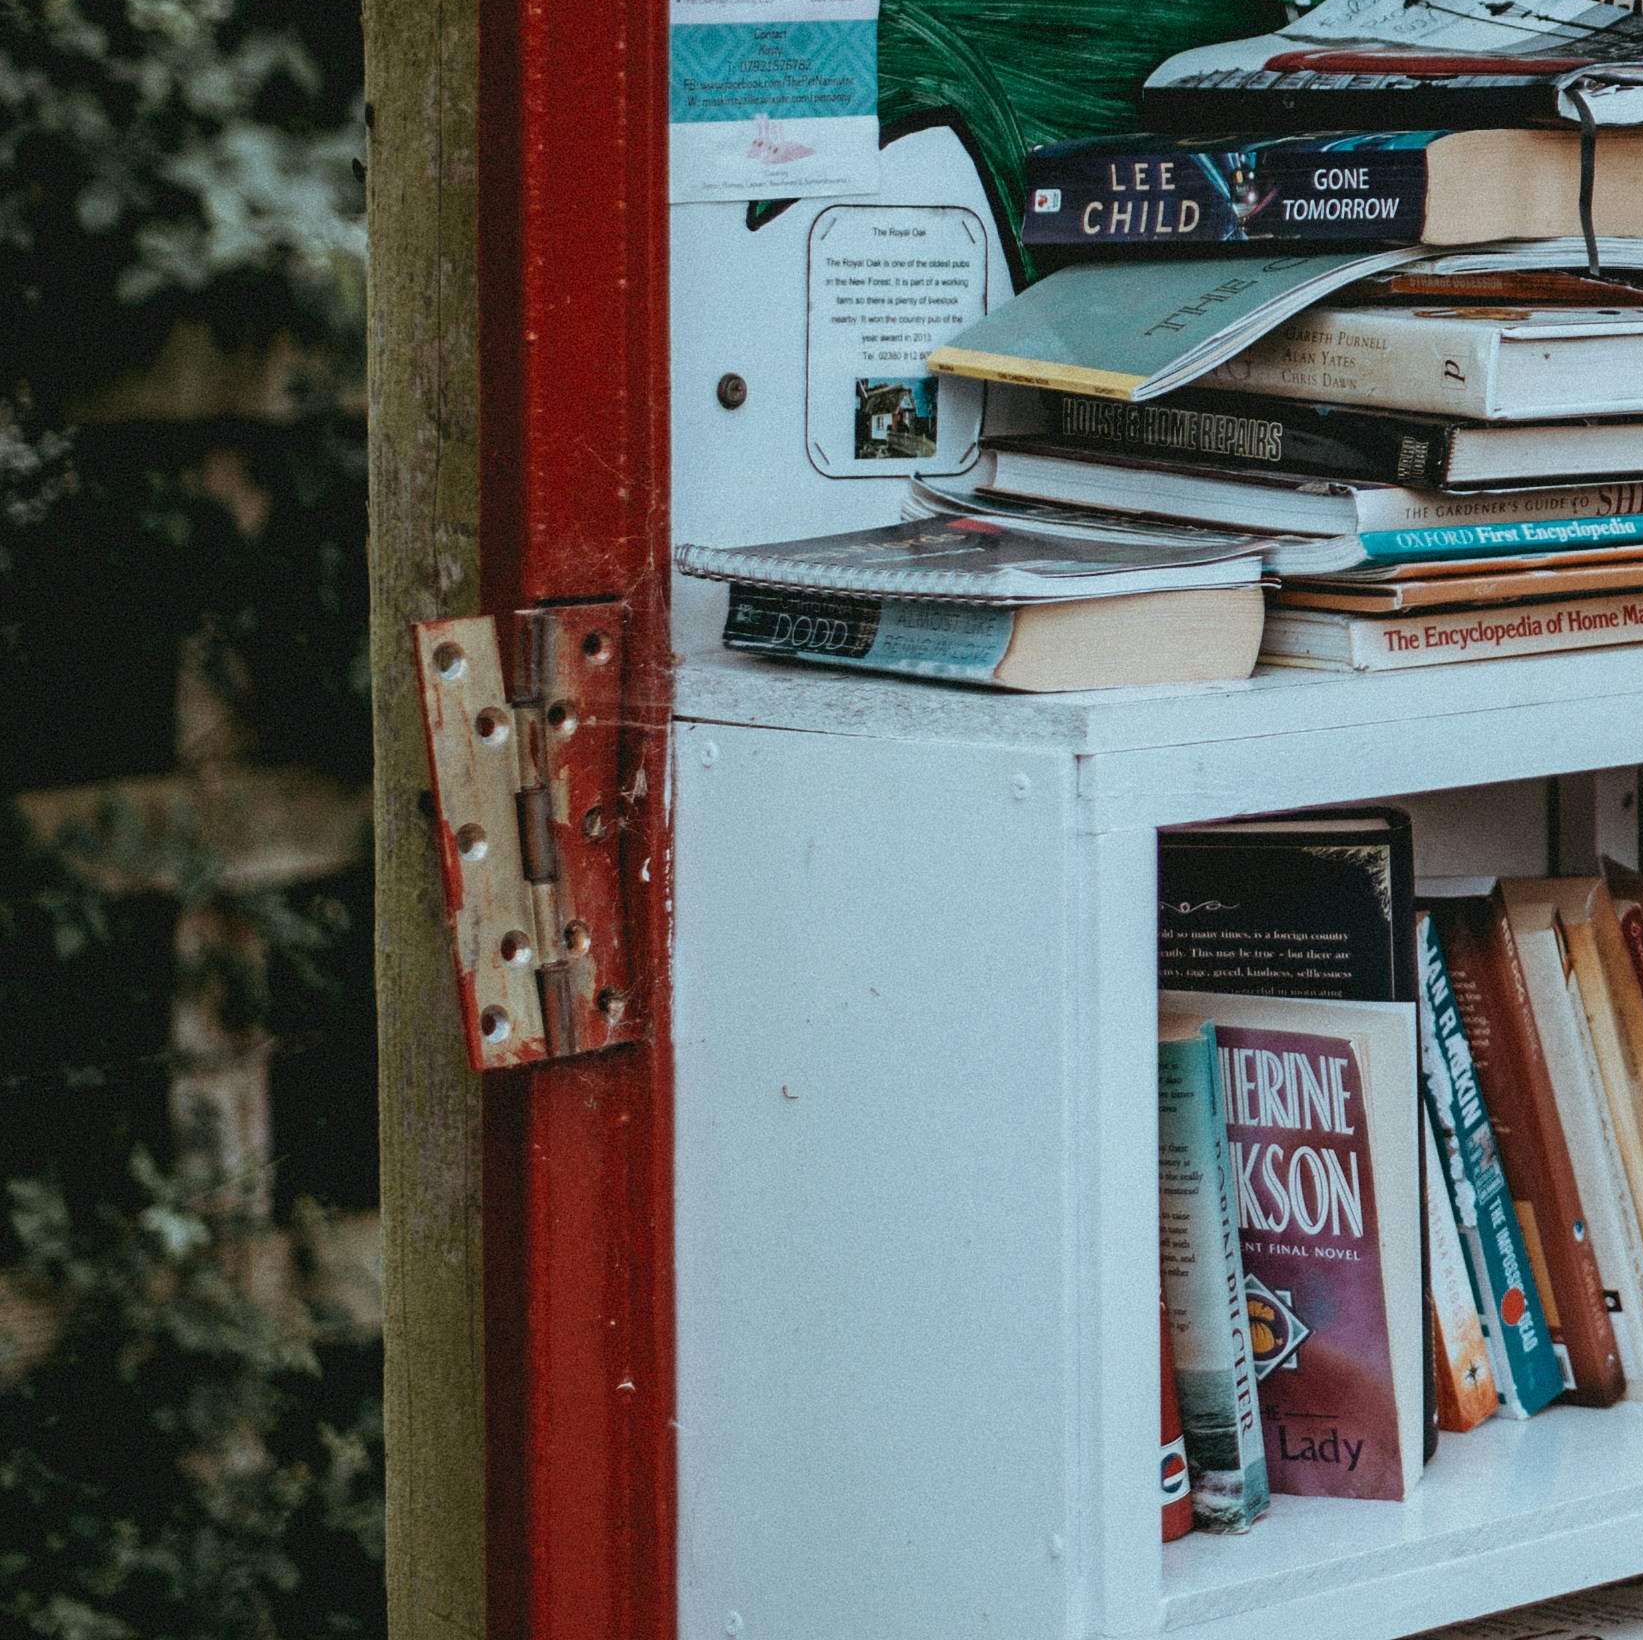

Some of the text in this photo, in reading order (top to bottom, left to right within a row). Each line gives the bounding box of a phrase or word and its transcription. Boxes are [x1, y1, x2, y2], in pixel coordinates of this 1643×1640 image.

[753, 28, 787, 40] Contact
[1111, 162, 1371, 191] LEE GONE
[1083, 197, 1400, 235] CHILD TOMORROW
[873, 227, 926, 238] The Royal Oak
[826, 258, 842, 267] The
[843, 258, 865, 269] Royal
[866, 259, 881, 267] Oak
[883, 259, 890, 267] is
[907, 259, 916, 268] of
[916, 259, 928, 267] the
[952, 259, 970, 269] pubs
[826, 278, 834, 286] in
[835, 278, 847, 286] the
[849, 278, 865, 286] New
[895, 278, 901, 286] It
[902, 278, 909, 286] is
[910, 278, 925, 288] part
[926, 278, 934, 286] of
[941, 278, 969, 288] working
[836, 296, 854, 305] farm
[866, 296, 886, 305] there
[887, 296, 894, 305] is
[895, 296, 917, 306] plenty
[919, 296, 927, 305] of
[928, 296, 958, 305] livestock
[1144, 278, 1261, 337] THE
[861, 315, 867, 323] It
[886, 315, 898, 323] the
[899, 316, 926, 325] country
[928, 315, 941, 325] pub
[943, 315, 950, 323] of
[952, 315, 964, 323] the
[861, 334, 911, 344] year award in
[1284, 326, 1389, 350] GARETH PURNELL
[1284, 347, 1357, 368] ALAN YATES
[1281, 368, 1357, 390] CHRIS DAWN
[1062, 398, 1285, 462] HOUSE & HOME REPAIRS
[1397, 435, 1416, 480] WARD
[1405, 507, 1430, 520] THE
[1436, 498, 1519, 518] GARDENER'S
[1525, 495, 1566, 512] GUIDE
[1396, 517, 1637, 549] OXFORD First Encyclopedia
[772, 613, 848, 650] DODD
[1384, 629, 1421, 652] The
[1424, 614, 1545, 649] Encyclopedia
[1546, 612, 1564, 635] of
[1567, 606, 1620, 632] Home
[1177, 931, 1188, 939] so
[1191, 931, 1218, 941] many
[1254, 930, 1263, 939] is
[1273, 931, 1309, 941] foreign
[1310, 931, 1349, 942] country
[1189, 947, 1352, 960] This may be true but there are
[1426, 945, 1449, 1008] IAN
[1438, 1005, 1483, 1131] RANKIN
[1229, 1141, 1364, 1239] KSON
[1488, 1195, 1505, 1228] THE
[1269, 1242, 1362, 1262] FINAL NOVEL
[1225, 1271, 1255, 1437] PILCHER
[1279, 1424, 1364, 1472] Lady
